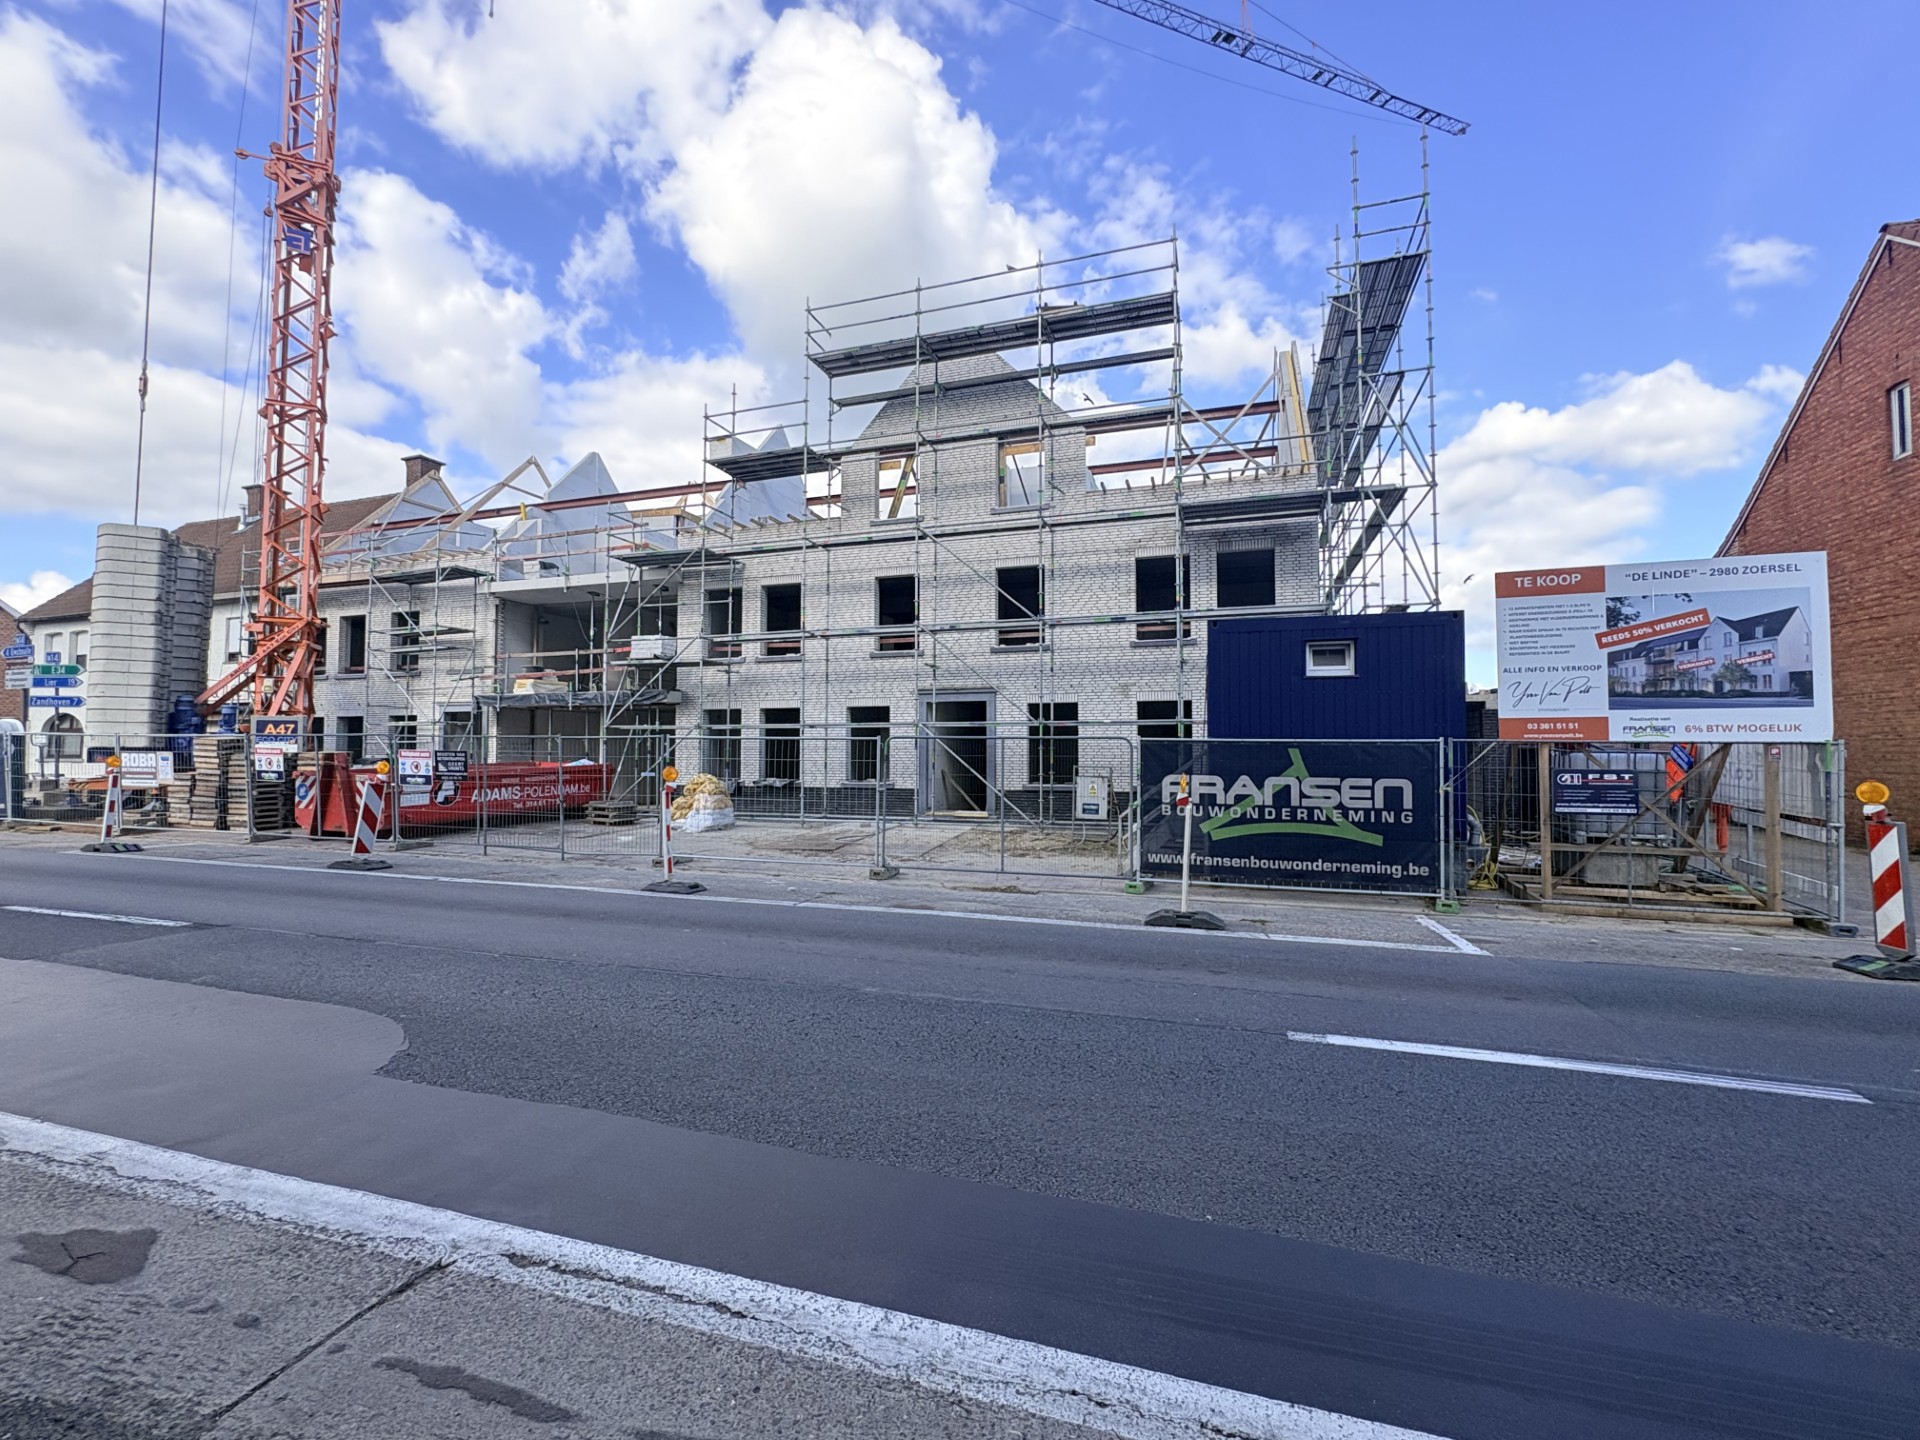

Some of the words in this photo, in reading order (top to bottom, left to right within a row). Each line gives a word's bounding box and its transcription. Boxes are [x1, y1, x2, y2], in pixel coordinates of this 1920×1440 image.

[1709, 566, 1739, 577] 2980
[1741, 563, 1802, 575] ZOERSEL
[1514, 577, 1532, 588] TE
[1537, 574, 1581, 587] KOOP
[1601, 631, 1630, 644] REEDS
[1632, 626, 1652, 637] 50%
[1653, 614, 1704, 631] VERKOCHT
[1678, 659, 1713, 669] VERKOCHT
[1736, 653, 1773, 664] VERKOCHT
[52, 666, 66, 674] E34
[1561, 664, 1602, 672] VERKOOP
[31, 697, 70, 706] Zandhoven
[264, 723, 295, 735] A47
[1685, 724, 1703, 733] 6%
[1706, 724, 1734, 733] BTW
[1737, 723, 1802, 732] MOGELIJK
[121, 753, 156, 767] ROBA
[1162, 774, 1413, 810] FRANSEN
[1161, 804, 1413, 824] BOUWONDERNEMING
[1148, 852, 1430, 878] wwwfransenbouwonderneming.be
